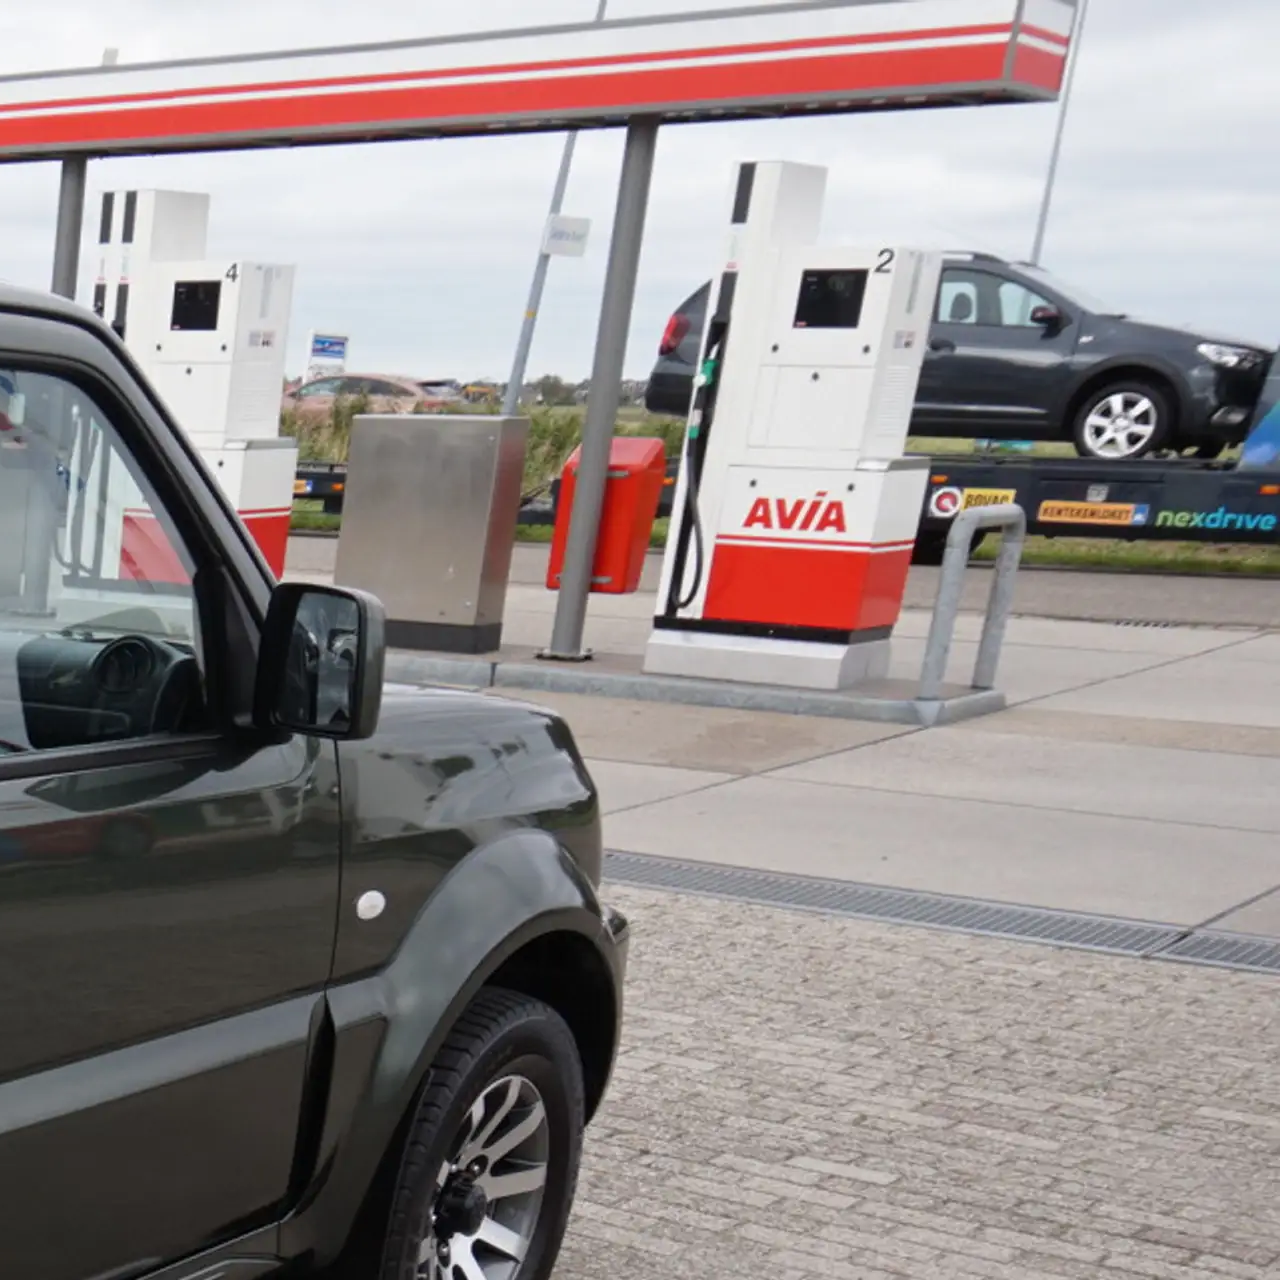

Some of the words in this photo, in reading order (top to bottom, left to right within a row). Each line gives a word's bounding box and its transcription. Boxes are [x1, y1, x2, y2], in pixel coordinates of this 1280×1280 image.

[225, 263, 238, 282] 4
[874, 248, 895, 273] 2
[1155, 504, 1277, 531] nexdrive
